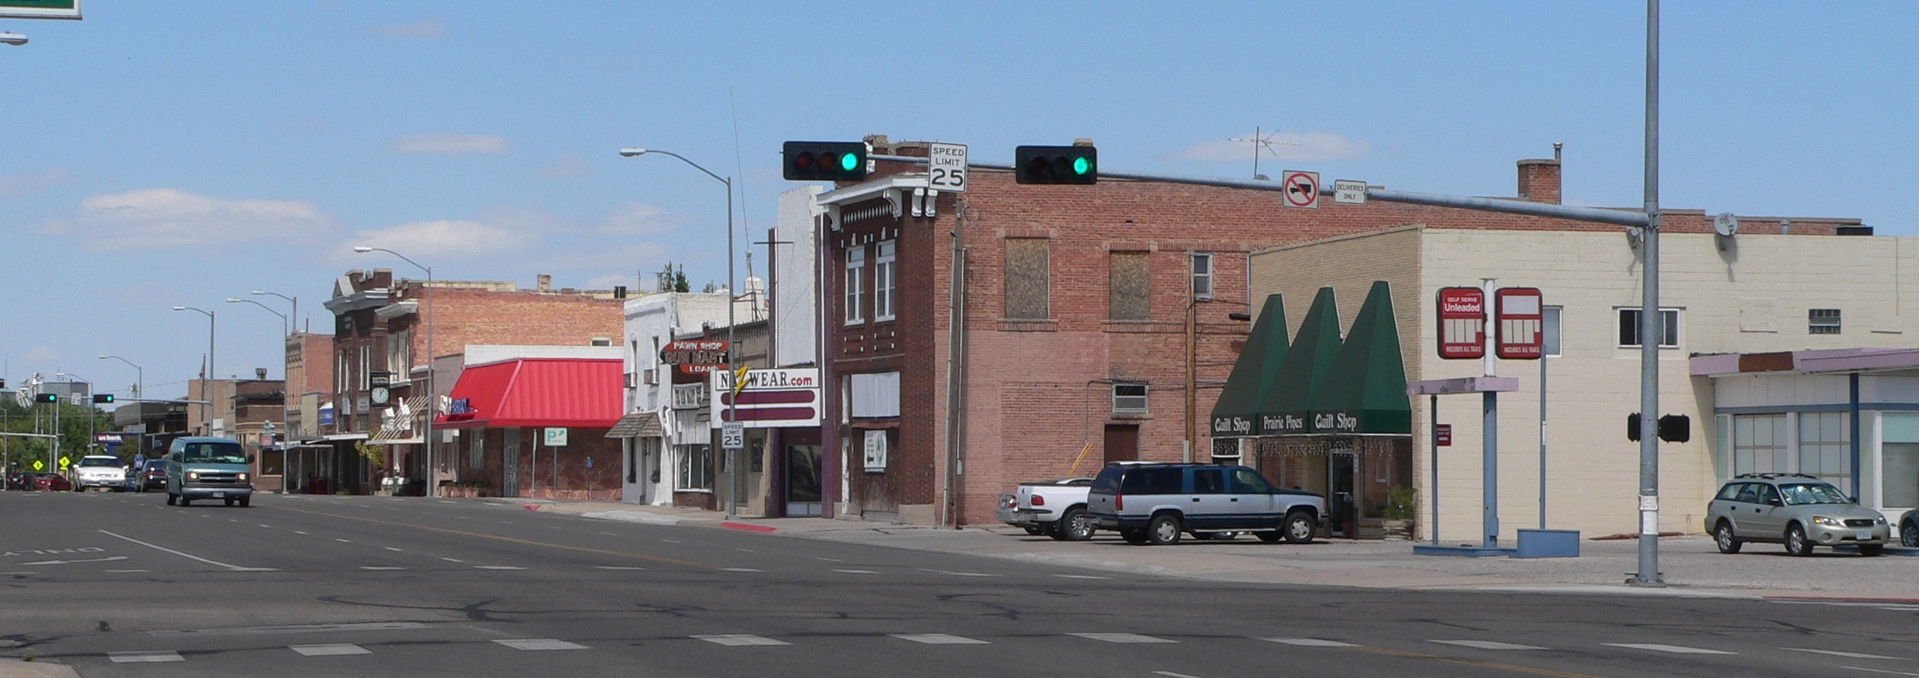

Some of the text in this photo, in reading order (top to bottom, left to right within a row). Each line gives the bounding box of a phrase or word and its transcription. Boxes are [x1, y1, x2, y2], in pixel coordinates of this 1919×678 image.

[933, 147, 964, 156] SPEED
[935, 158, 960, 166] LIMIT
[932, 168, 964, 186] 25
[1337, 184, 1363, 192] DELIVERIES
[1444, 303, 1480, 312] Unleaded
[673, 342, 723, 350] PAWN SHOP
[688, 365, 718, 373] LOAN
[1214, 416, 1251, 434] Quilt Shop
[1263, 414, 1303, 431] Prairie Pines
[1315, 412, 1357, 431] Quilt Shop
[723, 435, 742, 446] 25
